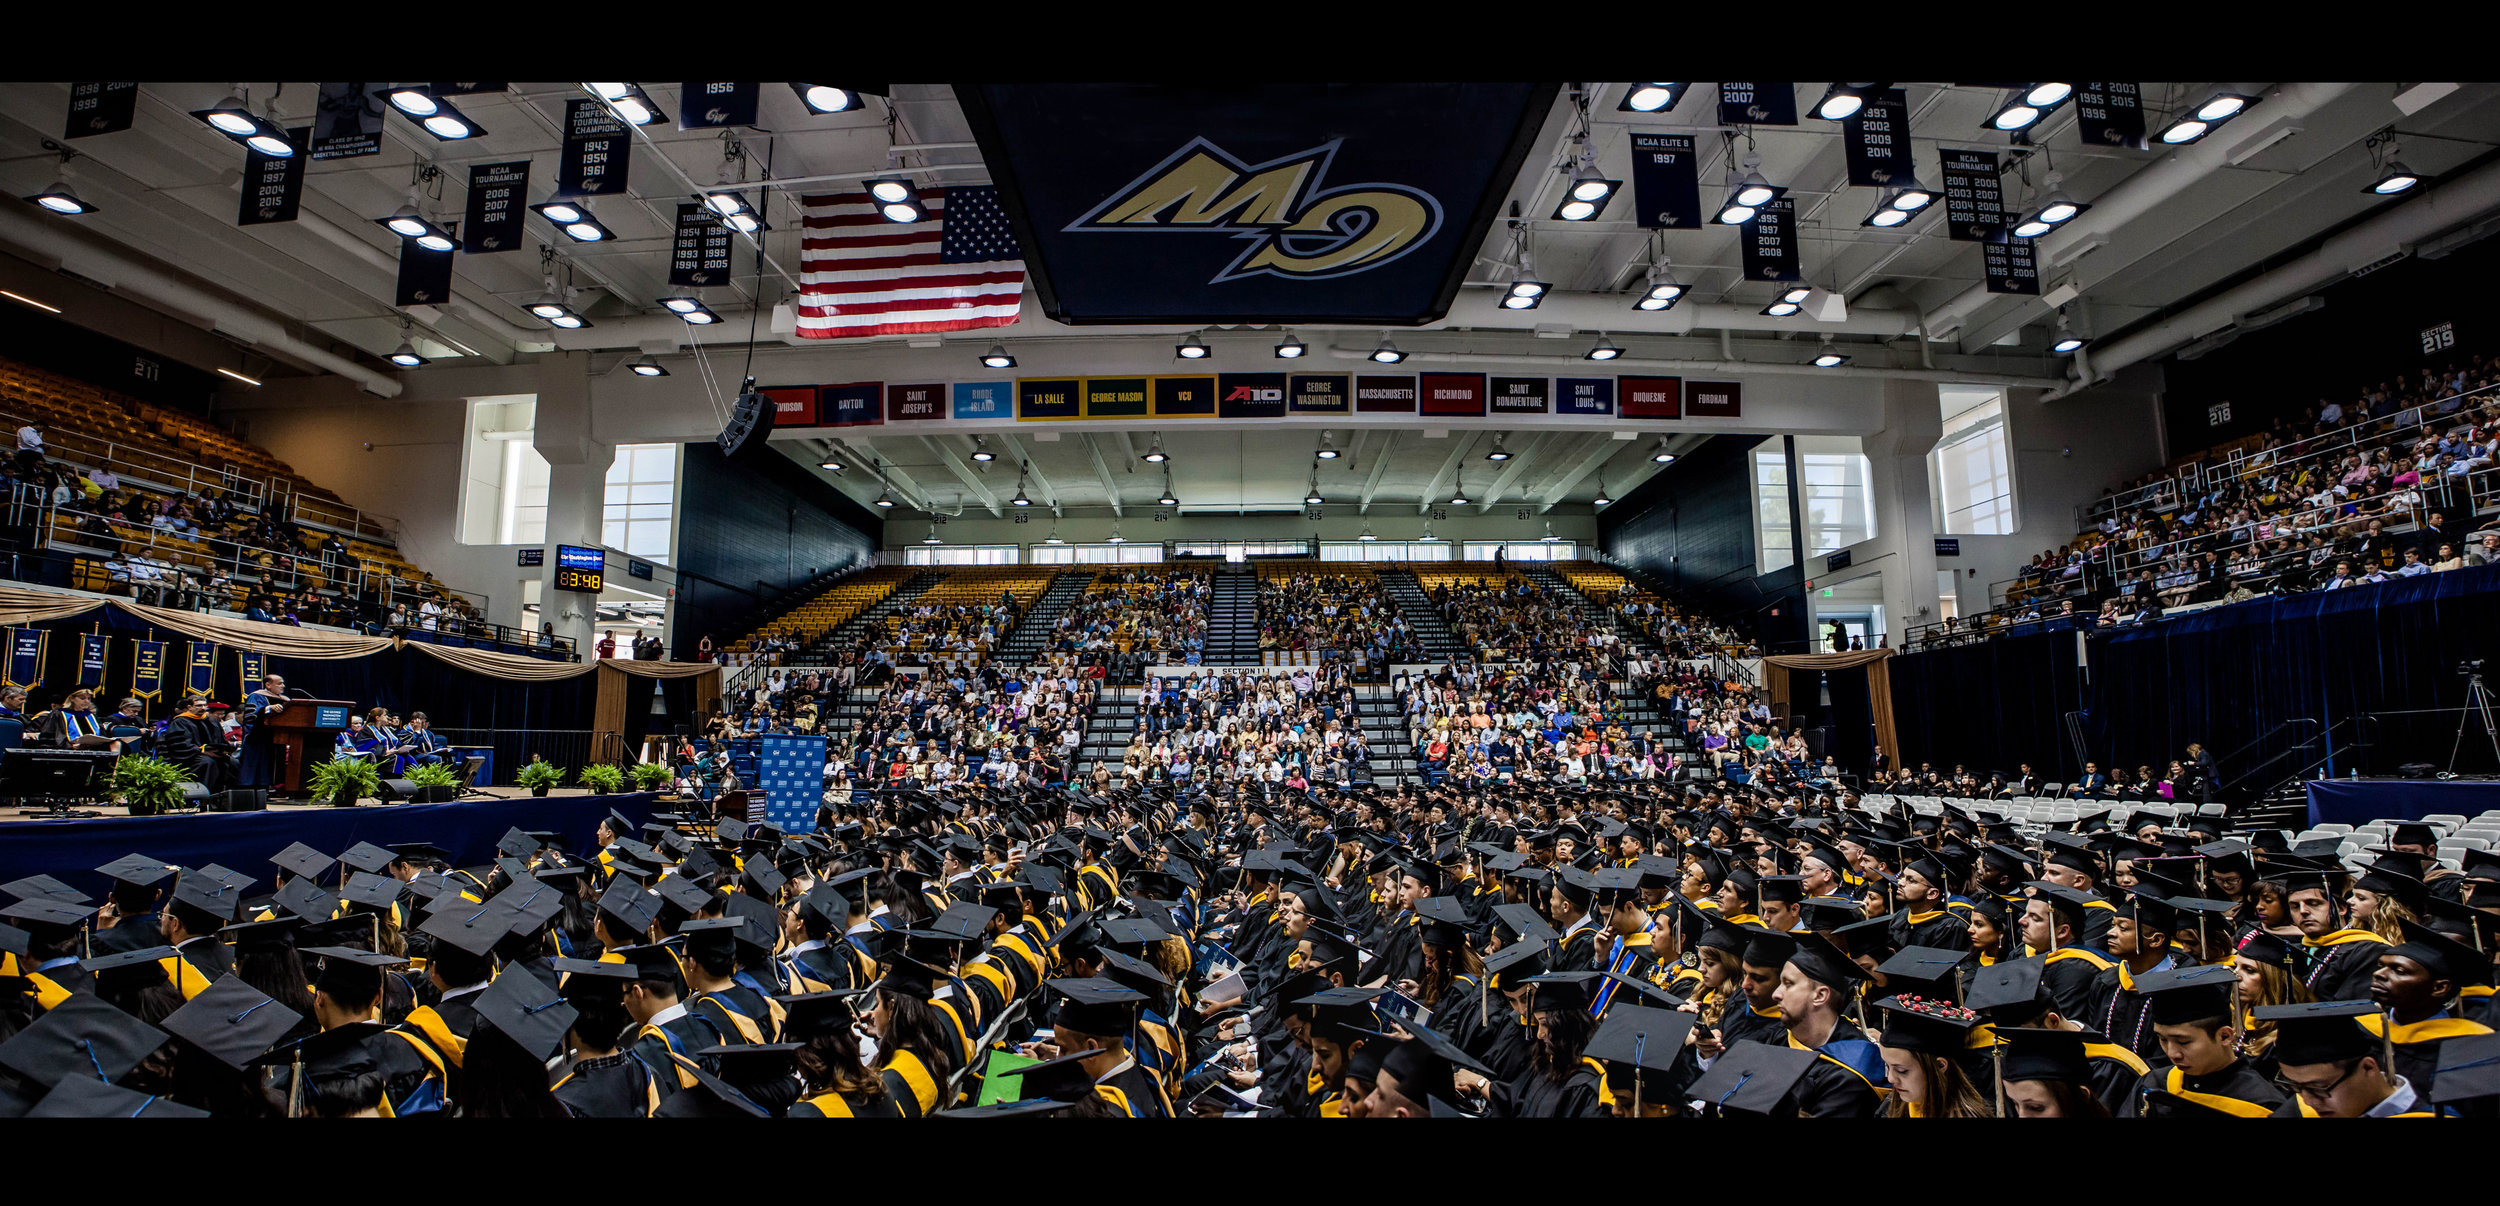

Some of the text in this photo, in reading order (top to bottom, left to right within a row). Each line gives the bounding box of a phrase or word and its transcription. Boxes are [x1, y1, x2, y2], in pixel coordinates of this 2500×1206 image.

[76, 83, 100, 96] 1998
[706, 82, 735, 94] 1956
[2109, 82, 2136, 94] 2003
[1724, 91, 1754, 104] 2007
[2080, 92, 2135, 108] 1995 2015
[74, 98, 98, 111] 1999
[2082, 107, 2106, 120] 1996
[1862, 121, 1890, 132] 2002
[1637, 138, 1689, 147] NCAA ELITE 8
[1864, 135, 1892, 145] 2009
[584, 141, 609, 152] 1943
[1867, 147, 1892, 158] 2014
[583, 153, 608, 164] 1954
[1653, 153, 1675, 164] 1997
[1960, 154, 1979, 163] NCAA
[264, 160, 286, 171] 1995
[490, 167, 510, 175] NCAA
[583, 166, 605, 176] 1961
[1946, 161, 1994, 172] TOURNAMENT
[263, 173, 285, 183] 1997
[475, 173, 524, 184] TOURNAMENT
[1946, 177, 1998, 188] 2001 2006
[259, 185, 285, 196] 2004
[485, 189, 510, 199] 2006
[1948, 188, 1998, 200] 2003 2007
[259, 197, 282, 207] 2015
[485, 200, 509, 211] 2007
[1784, 201, 1792, 209] 16
[1950, 200, 2000, 212] 2004 2008
[484, 212, 506, 223] 2014
[1951, 212, 1975, 222] 2005
[1979, 214, 2000, 224] 2015
[679, 227, 727, 237] 1954 1996
[1759, 225, 1778, 234] 1997
[678, 238, 727, 247] 1961 1998
[1758, 236, 1780, 245] 2007
[677, 249, 726, 258] 1993 1999
[1759, 248, 1782, 257] 2008
[1986, 245, 2029, 256] 1992 1997
[675, 260, 728, 269] 1994 2005
[1987, 256, 2031, 267] 1994 1998
[1988, 267, 2035, 278] 1995 2000
[2421, 322, 2452, 339] SECTION
[2423, 330, 2455, 354] 219
[135, 363, 159, 381] 211
[1306, 382, 1332, 393] GEORGE
[1509, 384, 1529, 394] SAINT
[1575, 385, 1595, 396] SAINT
[906, 391, 927, 401] SAINT
[1034, 393, 1064, 405] LA SALLE
[1091, 391, 1143, 403] GEORGE MASON
[1178, 391, 1192, 401] VCU
[1224, 386, 1282, 401] A10
[1359, 389, 1413, 400] MASSACHUSETTS
[1434, 389, 1472, 400] RICHMOND
[1633, 392, 1666, 403] DUQUESNE
[838, 398, 864, 410] DAYTON
[1297, 394, 1341, 406] WASHINGTON
[1496, 396, 1543, 407] BONAVENTURE
[1575, 398, 1595, 408] LOUIS
[1698, 394, 1728, 405] FORDHAM
[901, 403, 933, 414] JOSEPH'S
[970, 400, 995, 412] ISLAND
[2209, 409, 2231, 426] 218
[934, 516, 947, 524] 212
[1154, 513, 1168, 521] 214
[1309, 512, 1322, 520] 215
[1433, 512, 1446, 520] 216
[1518, 512, 1531, 520] 217
